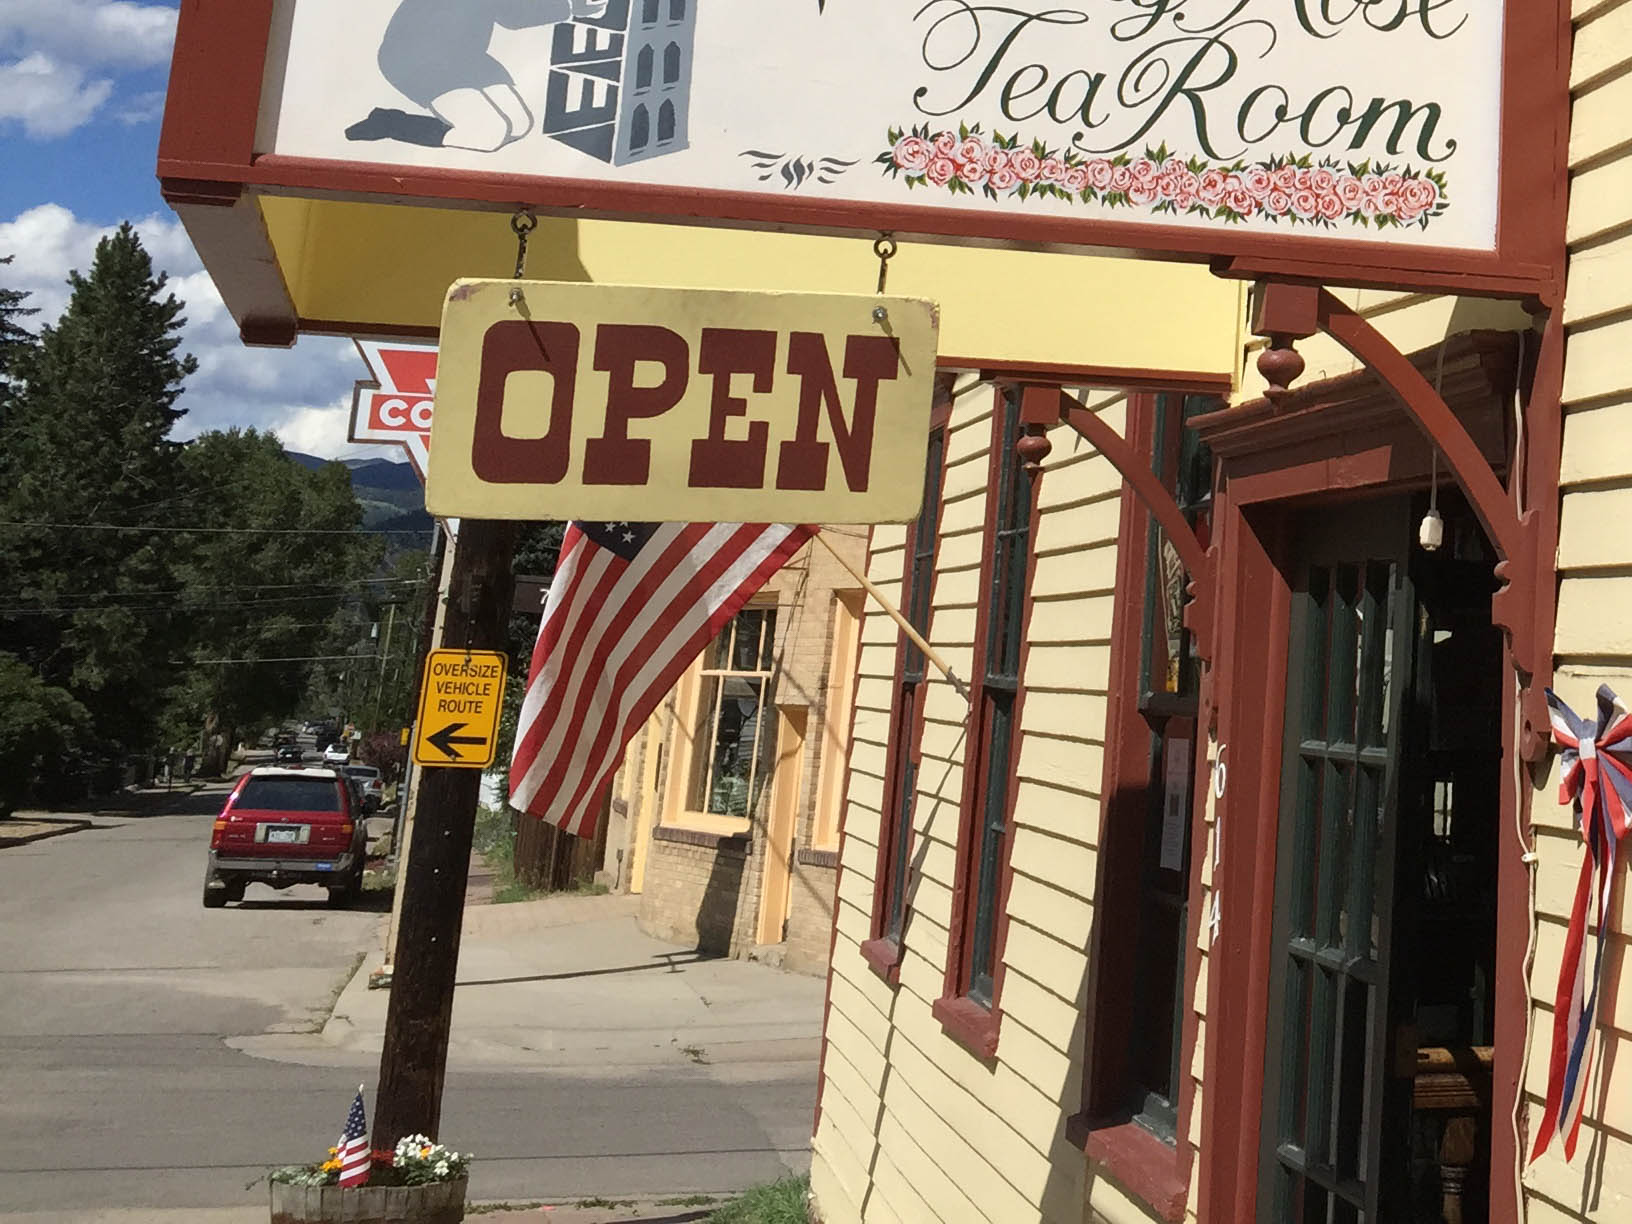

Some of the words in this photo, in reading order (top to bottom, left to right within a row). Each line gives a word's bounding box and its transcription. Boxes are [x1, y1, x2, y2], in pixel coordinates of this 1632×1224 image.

[1071, 19, 1458, 163] Room
[472, 319, 901, 493] OPEN
[433, 662, 500, 679] OVERSIZE
[436, 681, 492, 697] VEHICLE
[437, 699, 484, 715] ROUTE
